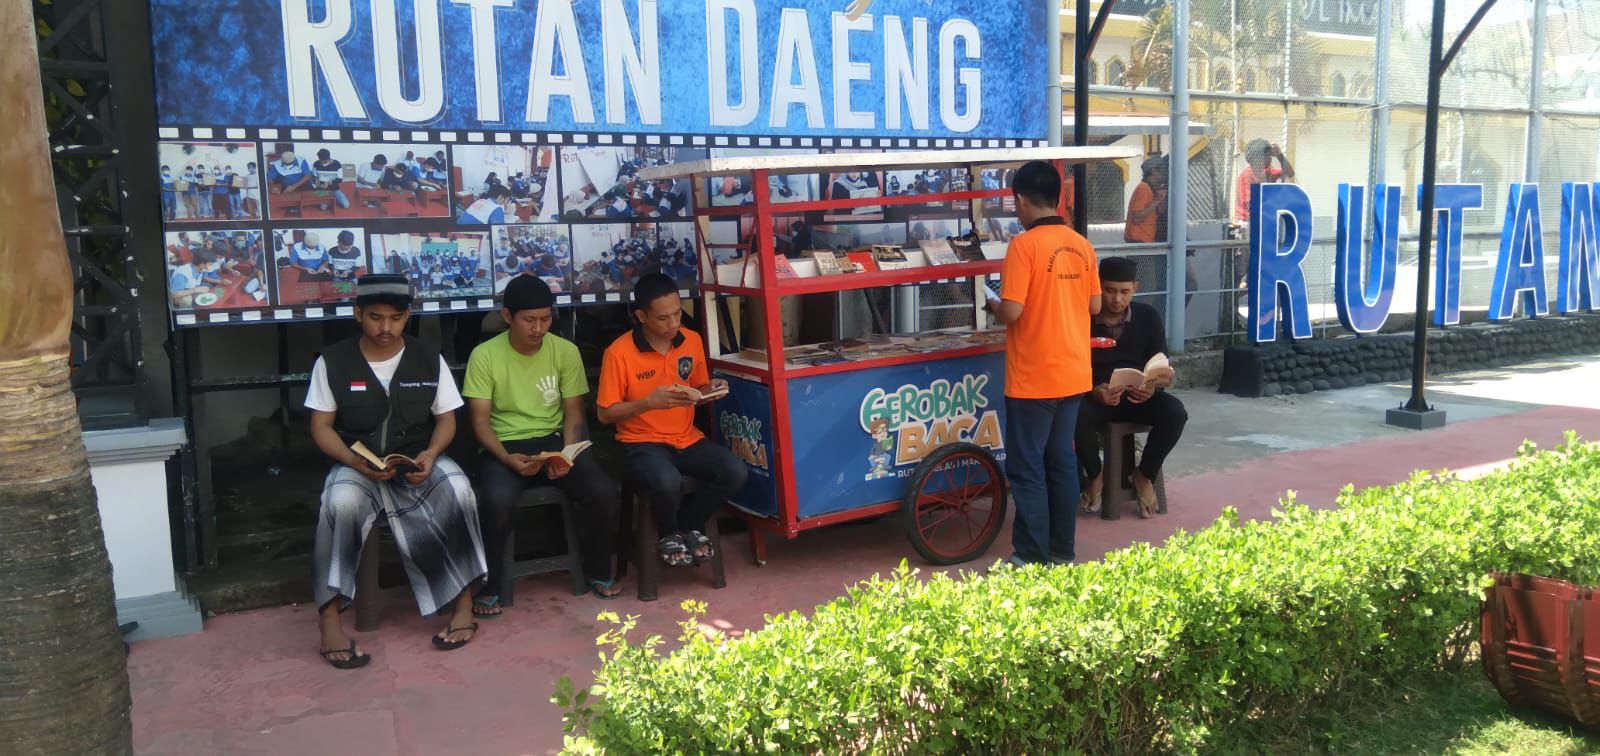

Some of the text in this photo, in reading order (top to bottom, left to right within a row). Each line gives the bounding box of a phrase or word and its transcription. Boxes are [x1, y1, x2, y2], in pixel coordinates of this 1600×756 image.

[281, 0, 984, 133] RUTAN DAENG
[1247, 181, 1600, 343] RUTAN
[635, 369, 657, 381] WBP
[861, 375, 988, 432] GEROBAK
[896, 410, 1004, 466] BACA
